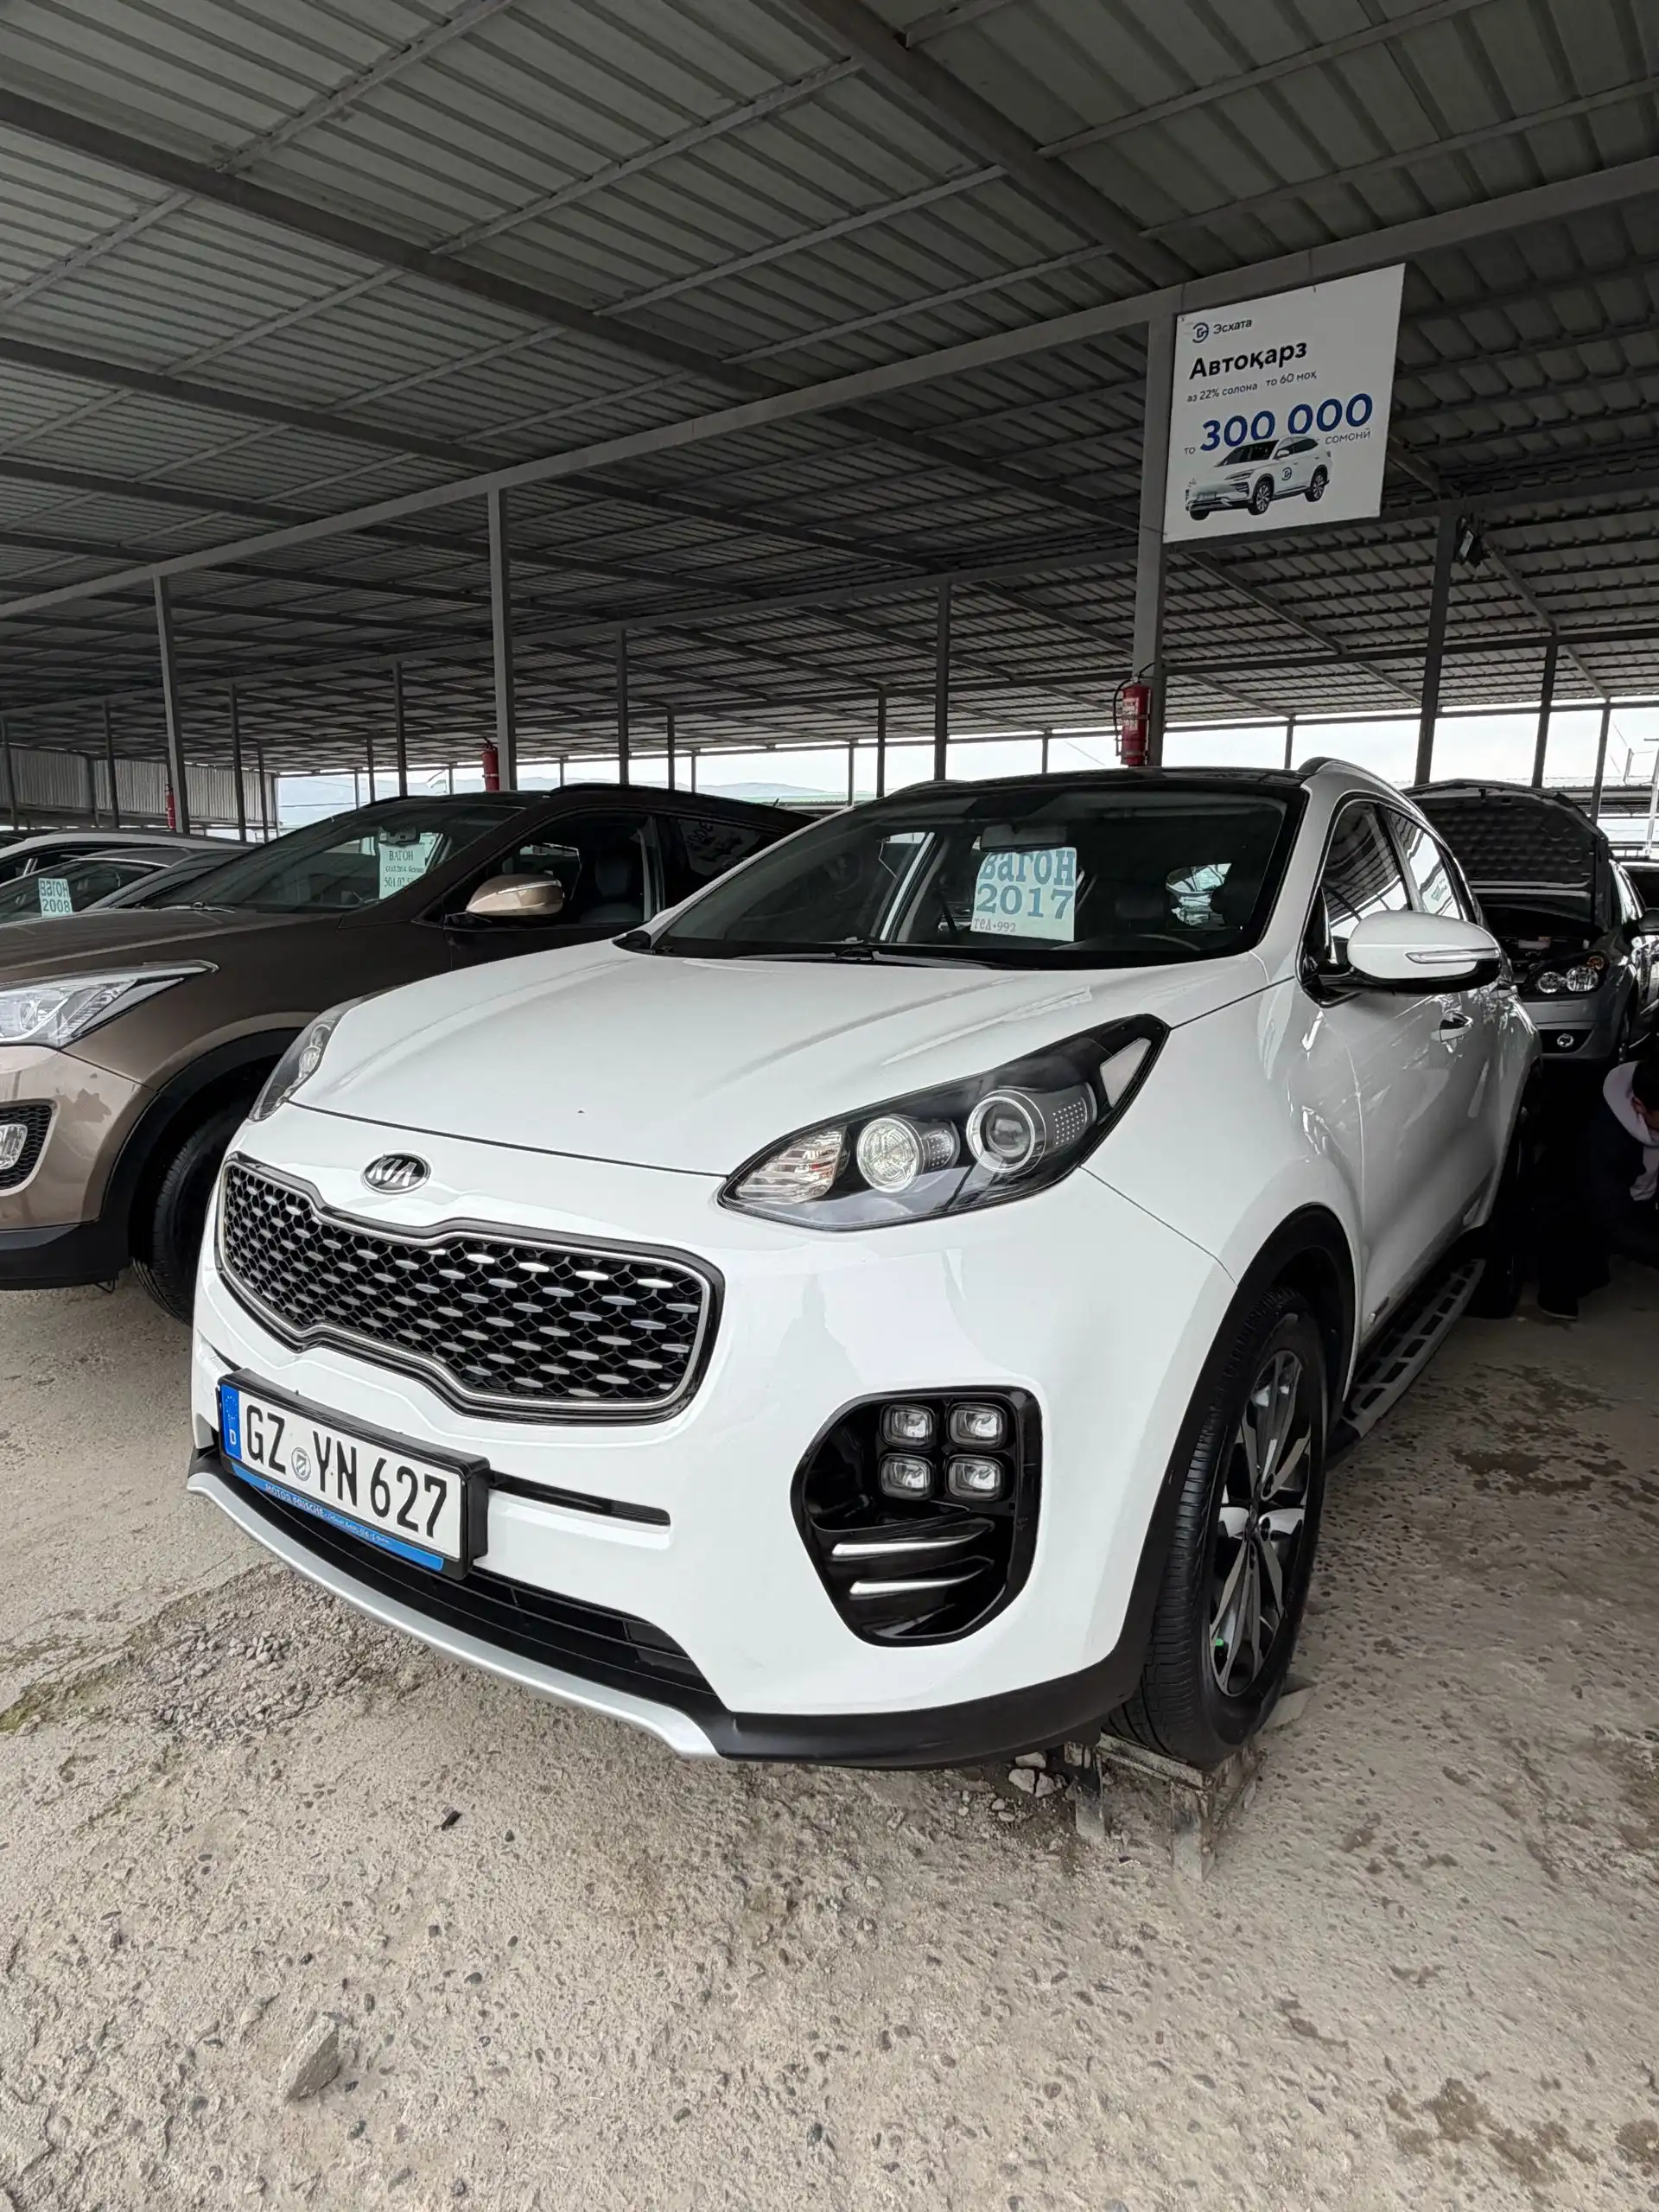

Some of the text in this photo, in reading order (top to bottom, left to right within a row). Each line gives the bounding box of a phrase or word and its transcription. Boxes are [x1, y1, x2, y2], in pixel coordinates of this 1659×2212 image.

[1213, 320, 1252, 334] Эсхата
[1189, 342, 1307, 380] Автоқарз
[1199, 388, 1220, 401] 22%
[1222, 383, 1258, 396] солона
[1266, 378, 1277, 387] то
[1280, 372, 1294, 385] 60
[1185, 447, 1196, 455] то
[1200, 410, 1275, 452] 300
[1287, 393, 1373, 435] 000
[389, 850, 414, 861] ВАГОН
[42, 899, 71, 912] 2008
[976, 883, 1074, 919] 2017
[367, 1156, 417, 1187] KIA
[229, 1428, 237, 1446] D
[246, 1404, 287, 1474] GZ
[313, 1430, 358, 1507] YN
[370, 1457, 448, 1539] 627
